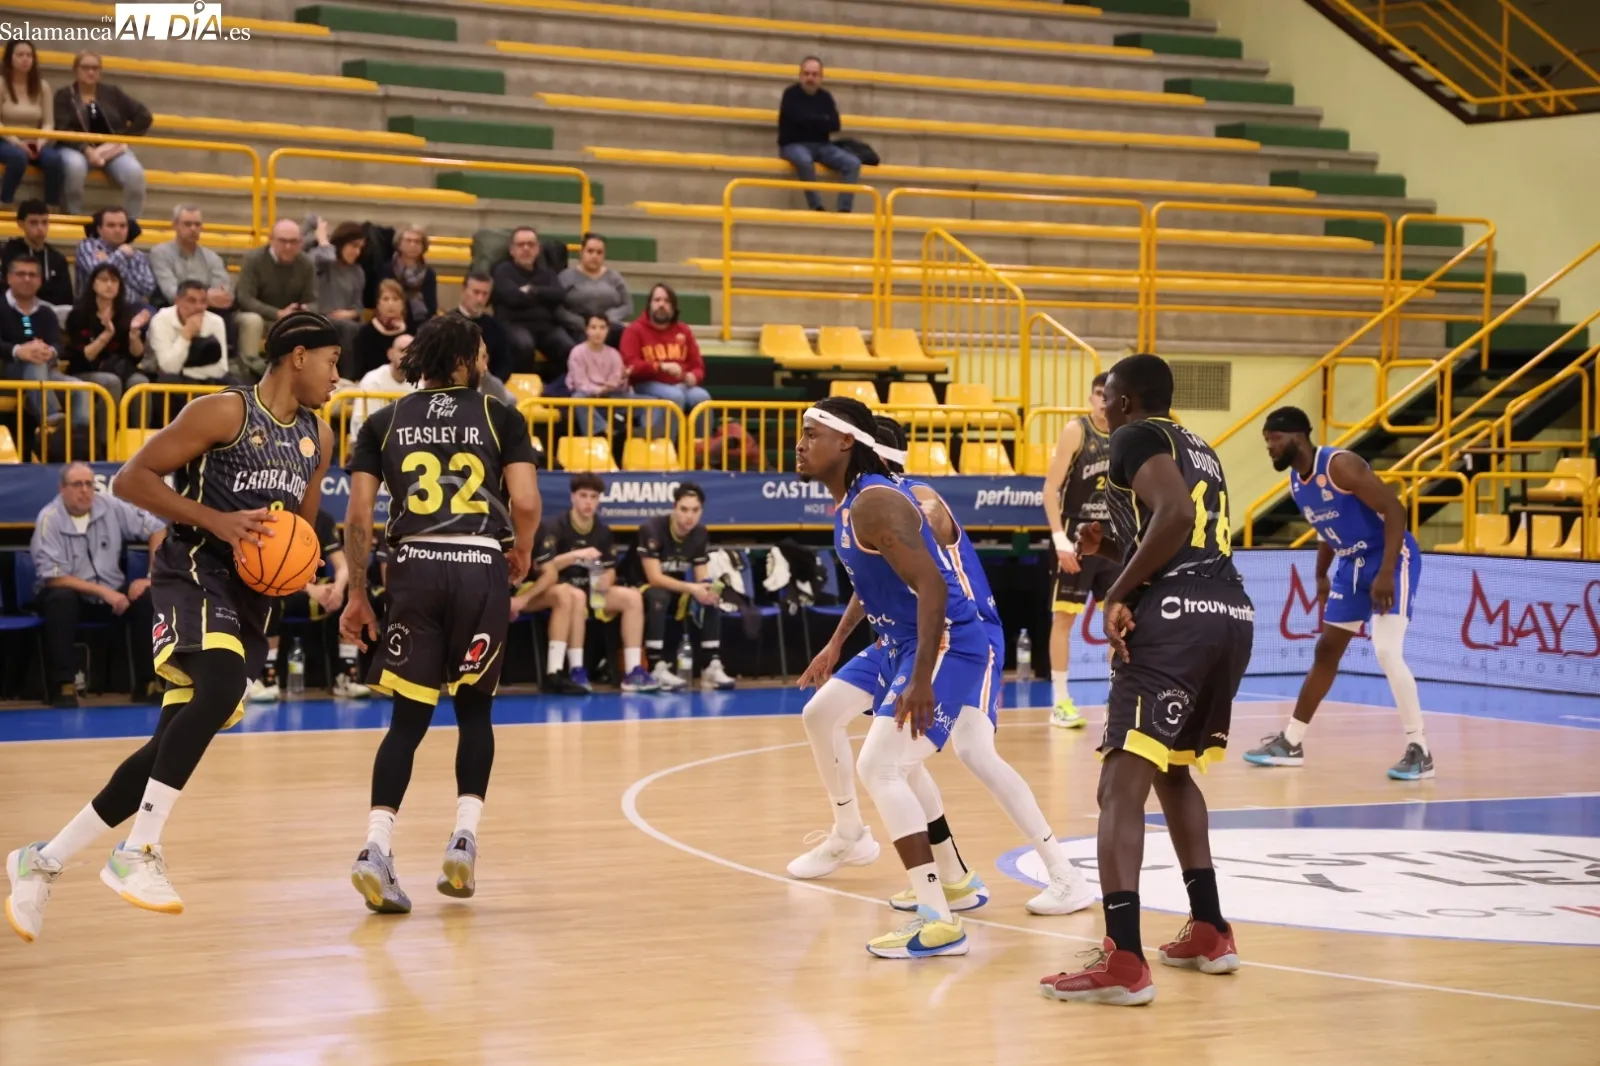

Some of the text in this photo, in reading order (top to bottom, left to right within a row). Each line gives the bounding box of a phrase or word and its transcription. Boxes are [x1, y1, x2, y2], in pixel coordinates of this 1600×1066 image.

[426, 403, 458, 420] Miel
[396, 426, 484, 446] TEASLEY JR.
[233, 469, 309, 505] CARBAJOS
[402, 451, 490, 515] 32
